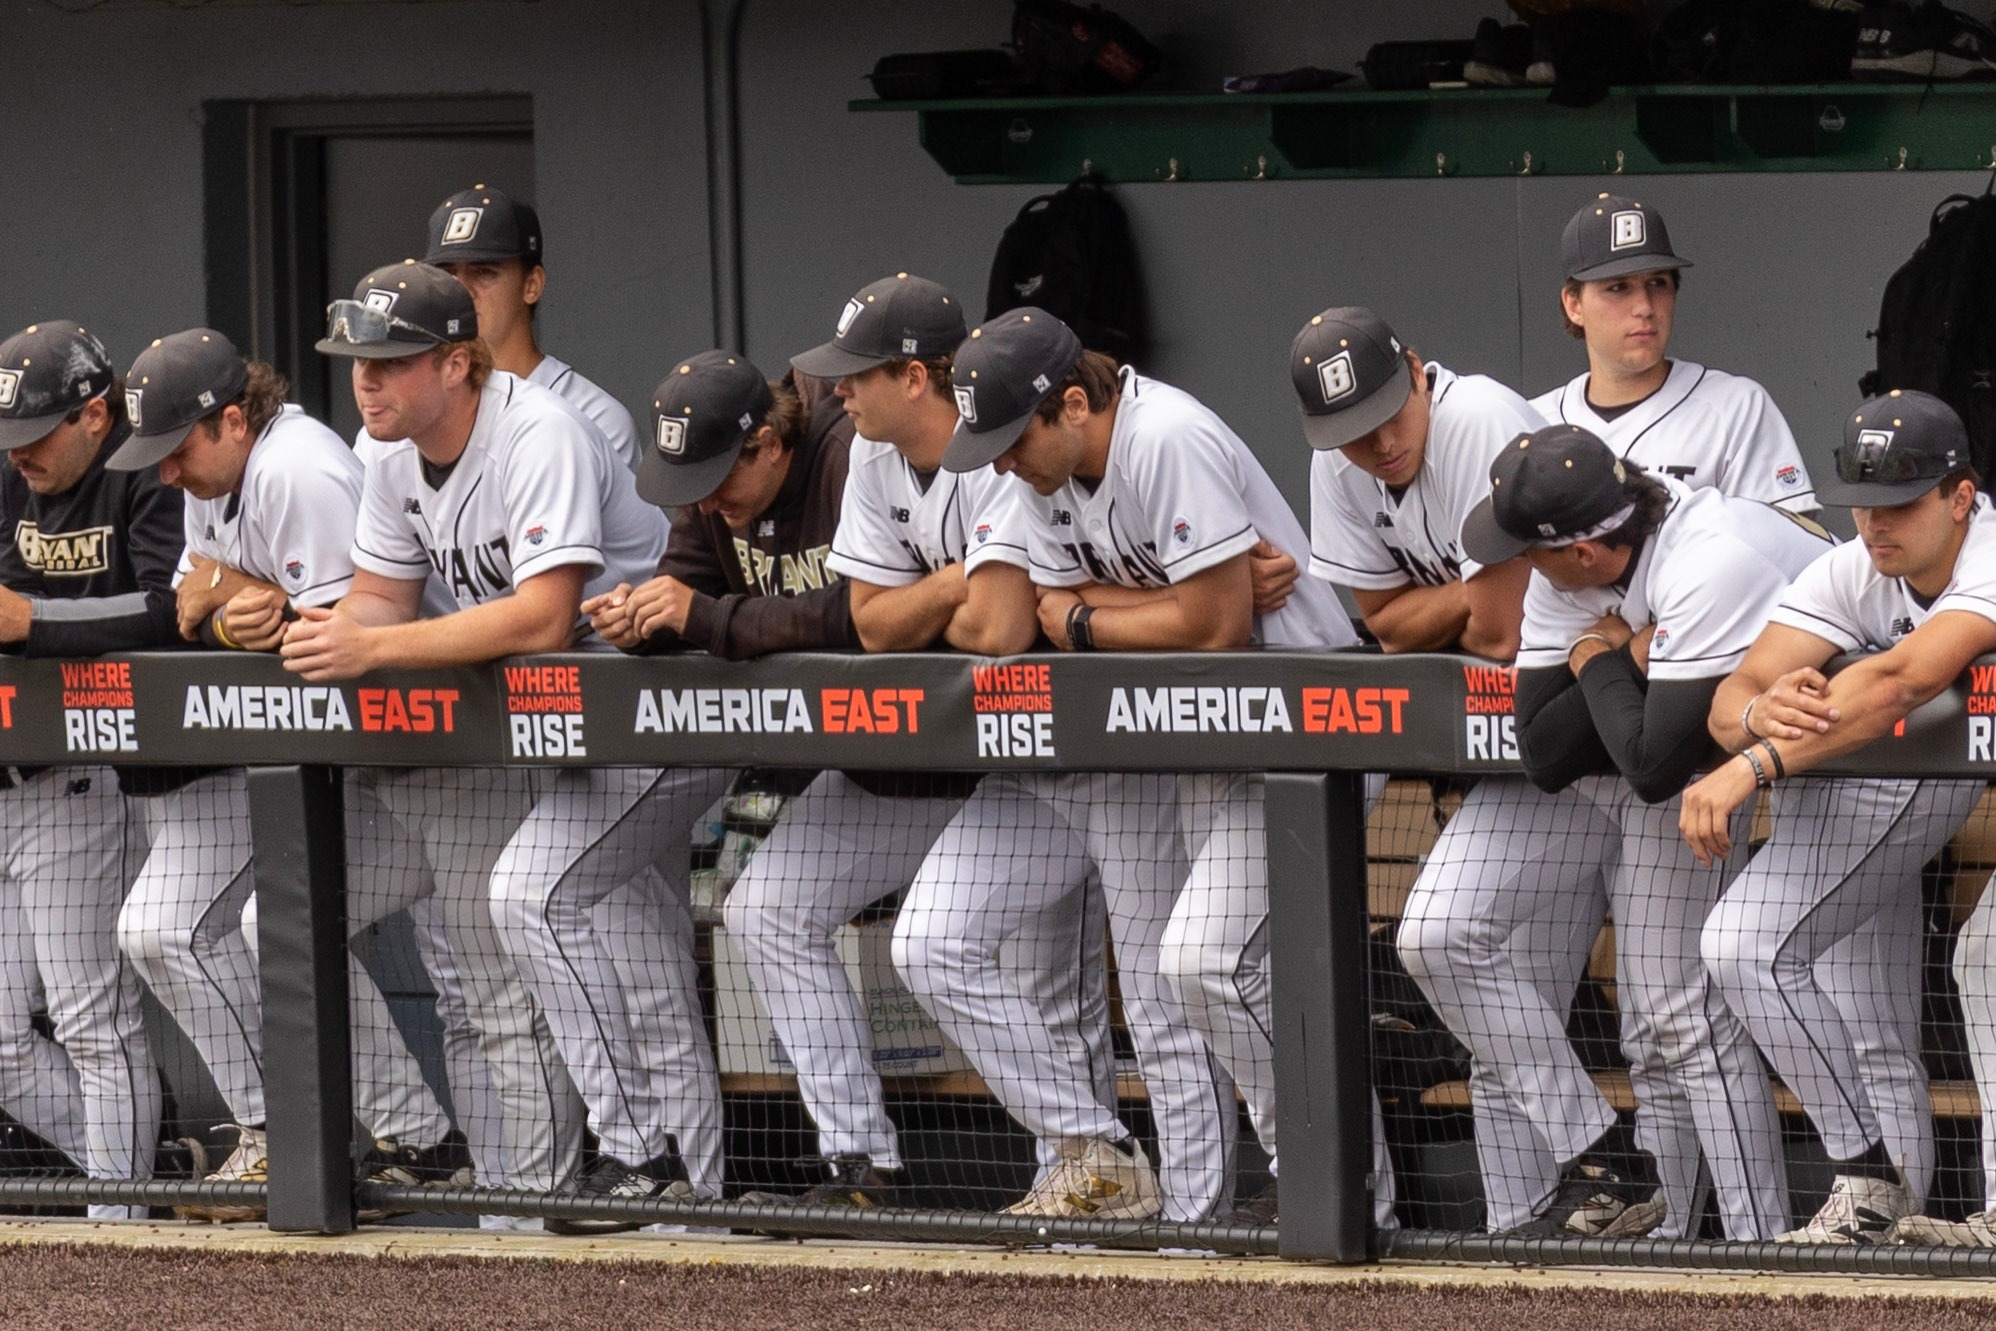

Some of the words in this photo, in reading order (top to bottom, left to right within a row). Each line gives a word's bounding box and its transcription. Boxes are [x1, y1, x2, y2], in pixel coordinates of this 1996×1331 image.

[444, 210, 481, 243] B
[1613, 212, 1645, 248] B
[1319, 353, 1354, 402] B
[658, 416, 686, 453] B
[61, 662, 132, 689] WHERE
[504, 666, 581, 693] WHERE
[972, 664, 1051, 692] WHERE
[1463, 665, 1519, 693] WHE
[63, 690, 134, 708] CHAMPIONS
[182, 686, 353, 731] AMERICA
[359, 689, 459, 732] EAST
[508, 696, 583, 712] CHAMPIONS
[634, 688, 813, 733] AMERICA
[821, 689, 924, 733] EAST
[974, 694, 1052, 711] CHAMPIONS
[1105, 687, 1293, 733] AMERICA
[1302, 688, 1410, 734] EAST
[64, 709, 139, 751] RISE
[510, 714, 587, 757] RISE
[976, 714, 1055, 758] RISE
[1466, 714, 1521, 760] RIS
